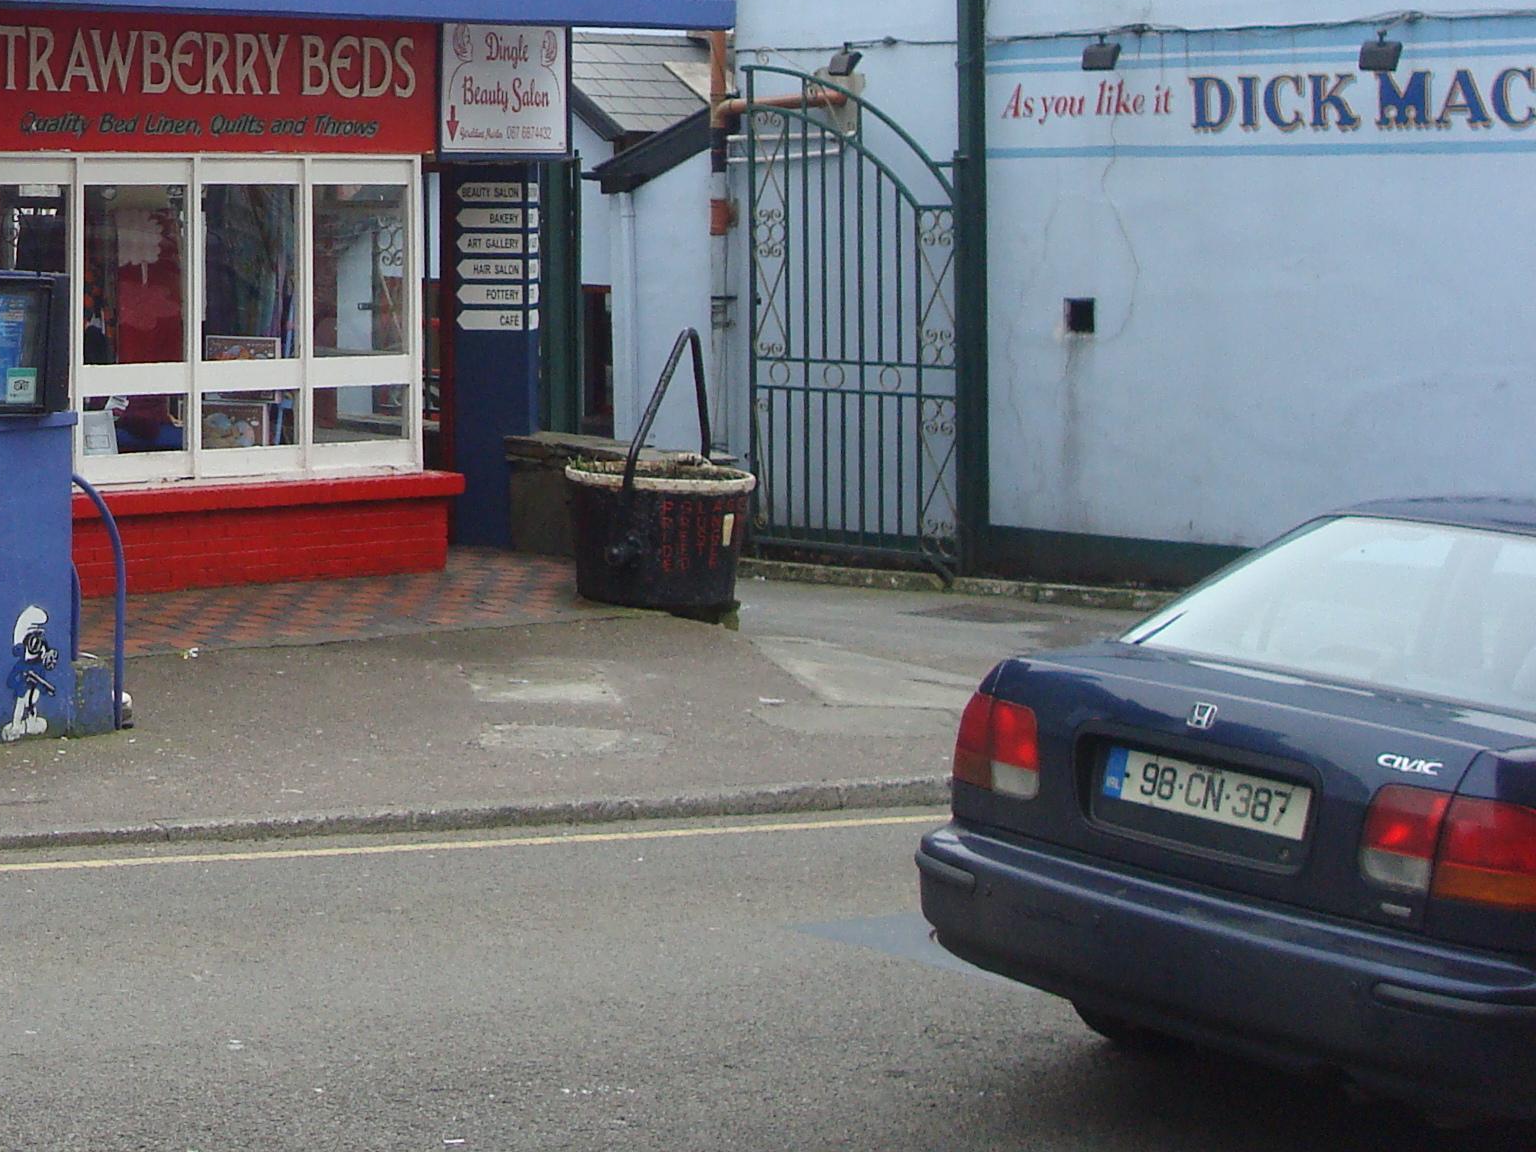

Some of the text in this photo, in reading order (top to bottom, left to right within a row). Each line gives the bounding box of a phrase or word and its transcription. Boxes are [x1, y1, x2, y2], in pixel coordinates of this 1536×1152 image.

[485, 32, 529, 70] Dingle
[301, 34, 417, 99] BEDS
[462, 75, 550, 113] Beauty Salon
[1001, 80, 1174, 126] As you like it
[1188, 73, 1361, 133] DICK
[19, 110, 379, 138] Quality Bed Linen, Quilts and Throws
[461, 187, 491, 198] BEAUTY
[494, 187, 520, 198] SALON
[489, 213, 519, 224] BAKERY
[467, 238, 519, 249] ART GALLERY
[473, 264, 520, 275] HAIR SALON
[486, 288, 519, 299] POTTERY
[1376, 752, 1444, 776] CIVIC
